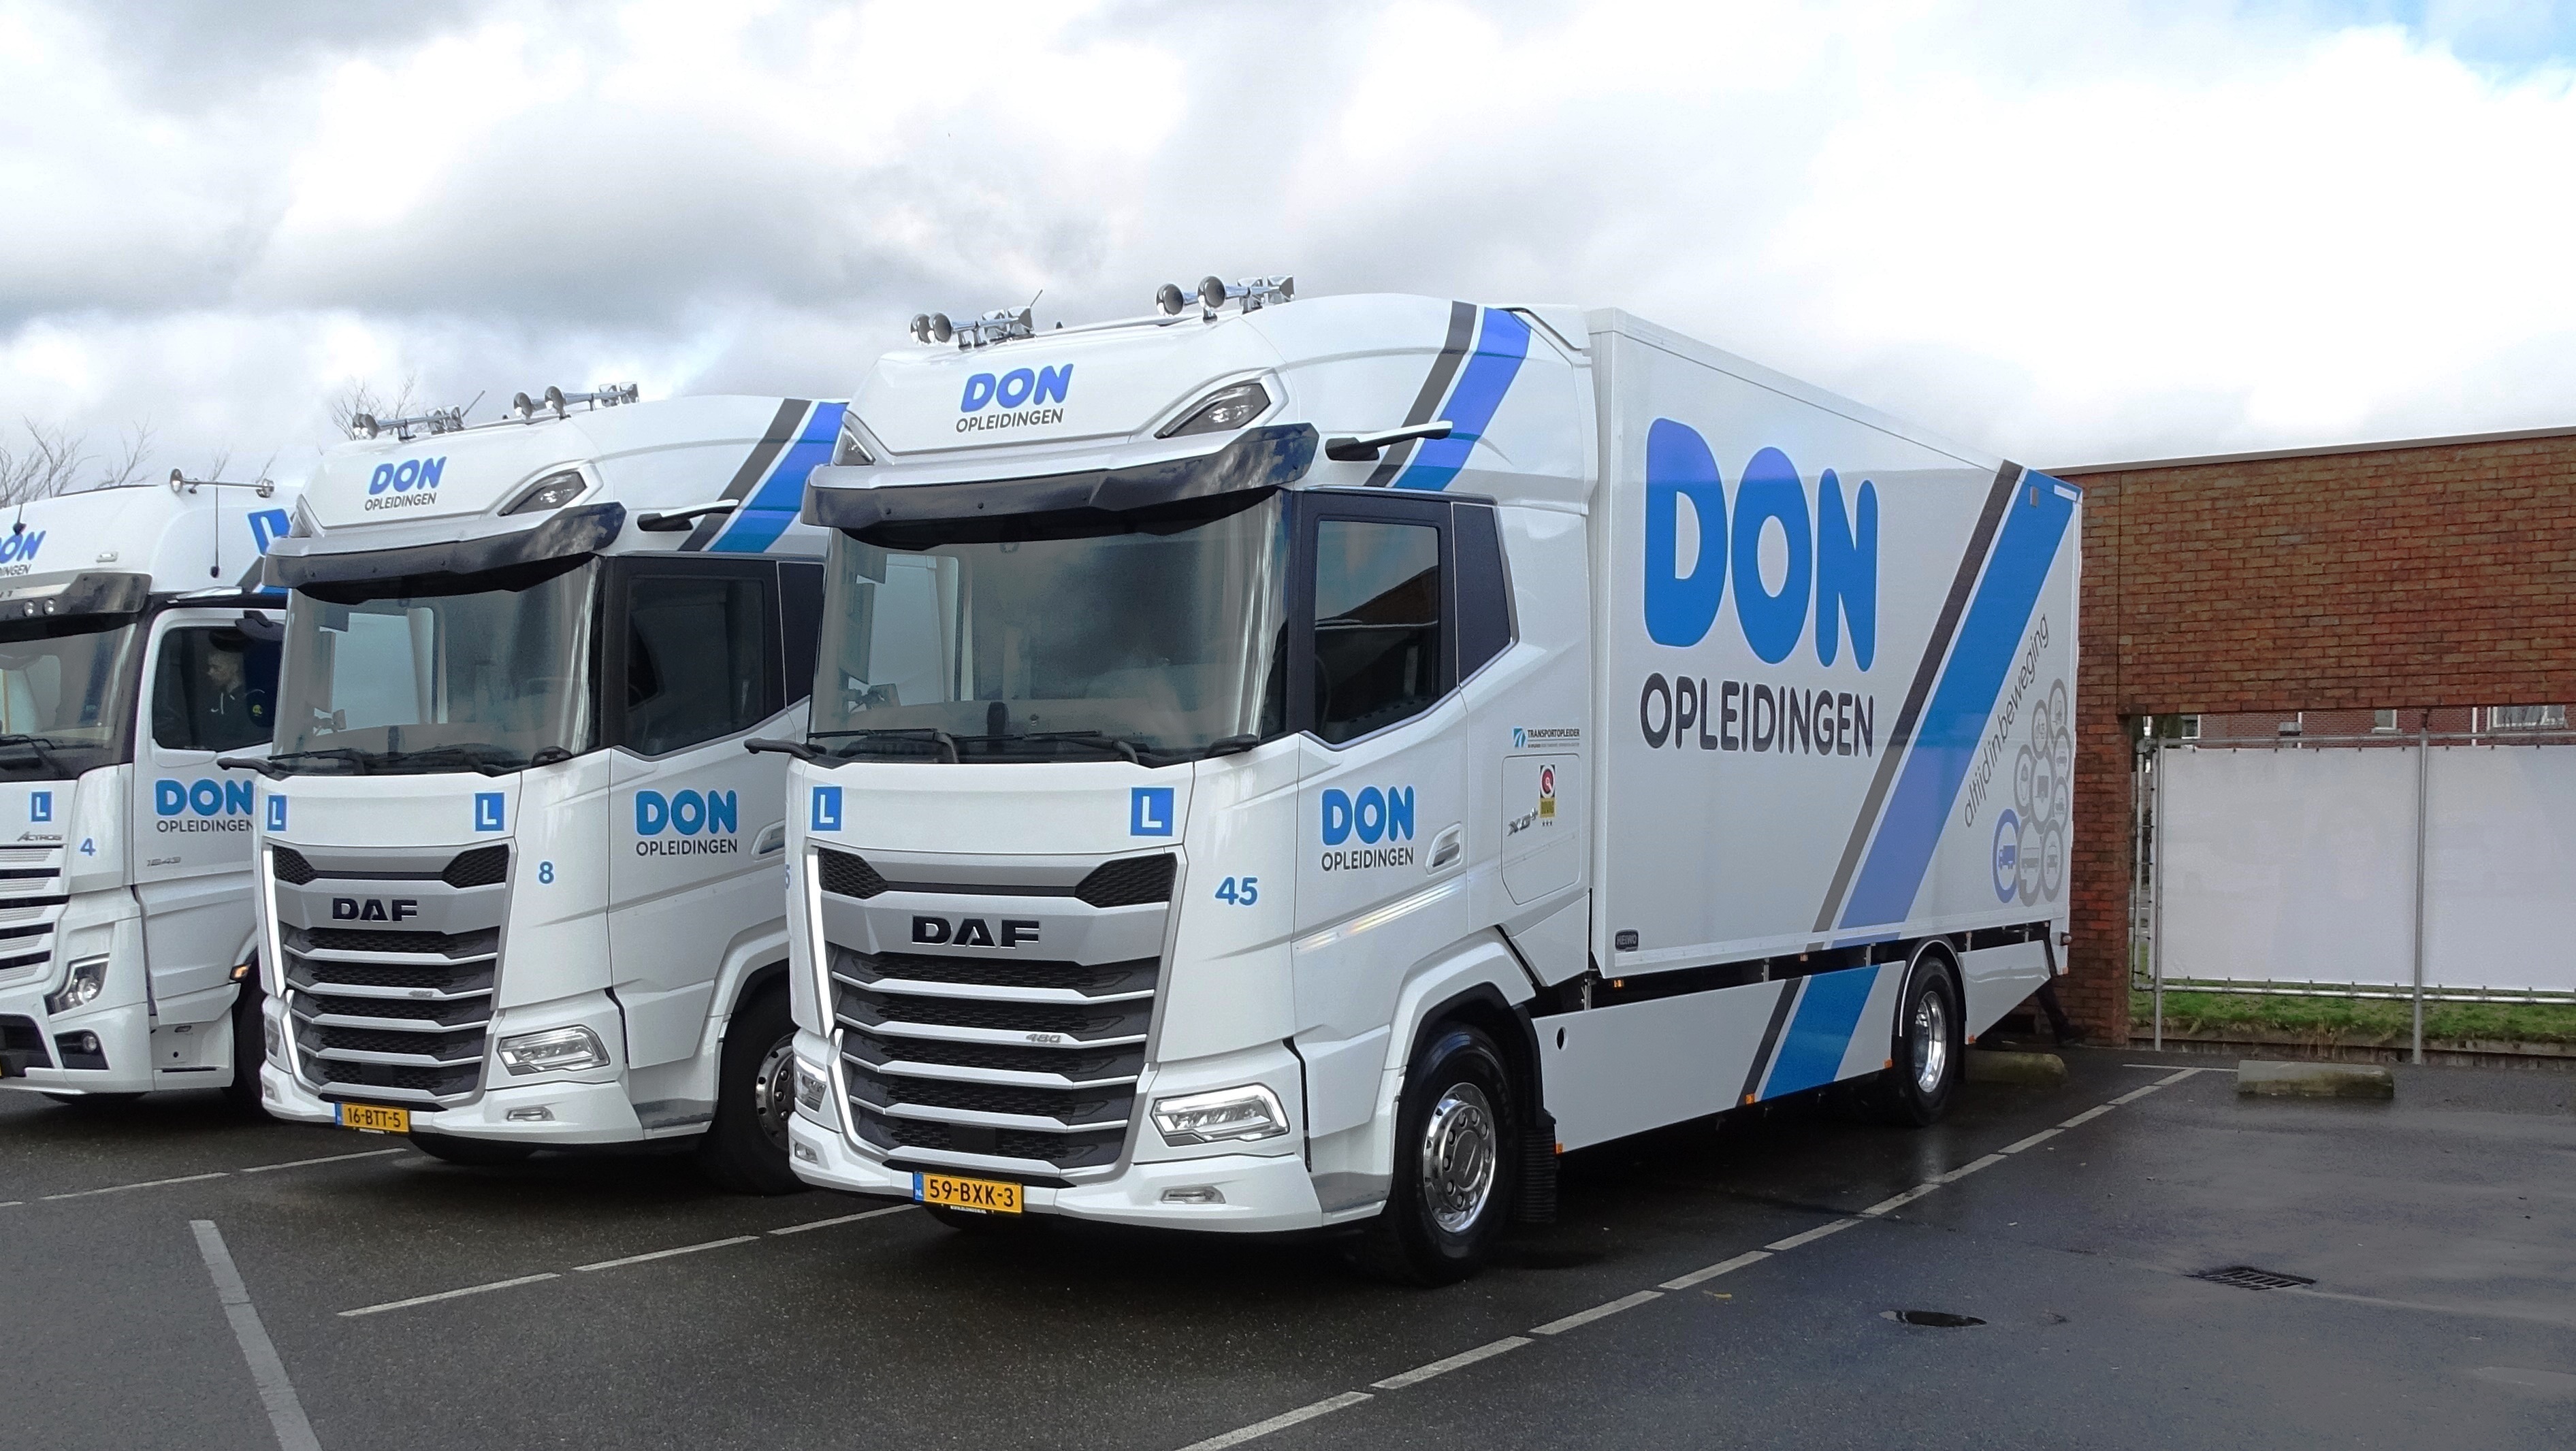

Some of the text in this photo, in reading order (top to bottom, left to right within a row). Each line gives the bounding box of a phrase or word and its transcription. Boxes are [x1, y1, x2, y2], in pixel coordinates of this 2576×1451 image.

[961, 363, 1074, 413] DON
[955, 407, 1063, 433] OPLEIDINGEN
[368, 456, 447, 495] DON
[364, 492, 437, 512] OPLEIDINGEN
[0, 530, 46, 564] ON
[1643, 417, 1880, 672] DON
[1639, 671, 1875, 758] OPLEIDINGEN
[1528, 728, 1580, 738] TRANSPORTOPLEIDER
[35, 796, 47, 817] L
[155, 778, 254, 817] DON
[819, 794, 834, 824] L
[272, 801, 282, 826] L
[482, 799, 497, 825] L
[636, 789, 738, 836] DON
[1142, 796, 1162, 828] L
[1321, 785, 1415, 847] DON
[80, 838, 96, 856] 4
[637, 839, 737, 855] OPLEIDINGEN
[1321, 847, 1414, 871] OPLEIDINGEN
[538, 862, 555, 884] 8
[1214, 876, 1259, 907] 45
[332, 898, 417, 922] DAF
[912, 916, 1040, 948] DAF
[1026, 1033, 1061, 1043] 480
[348, 1107, 401, 1128] 16-BTT-5
[930, 1178, 1014, 1207] 59-BXK-3
